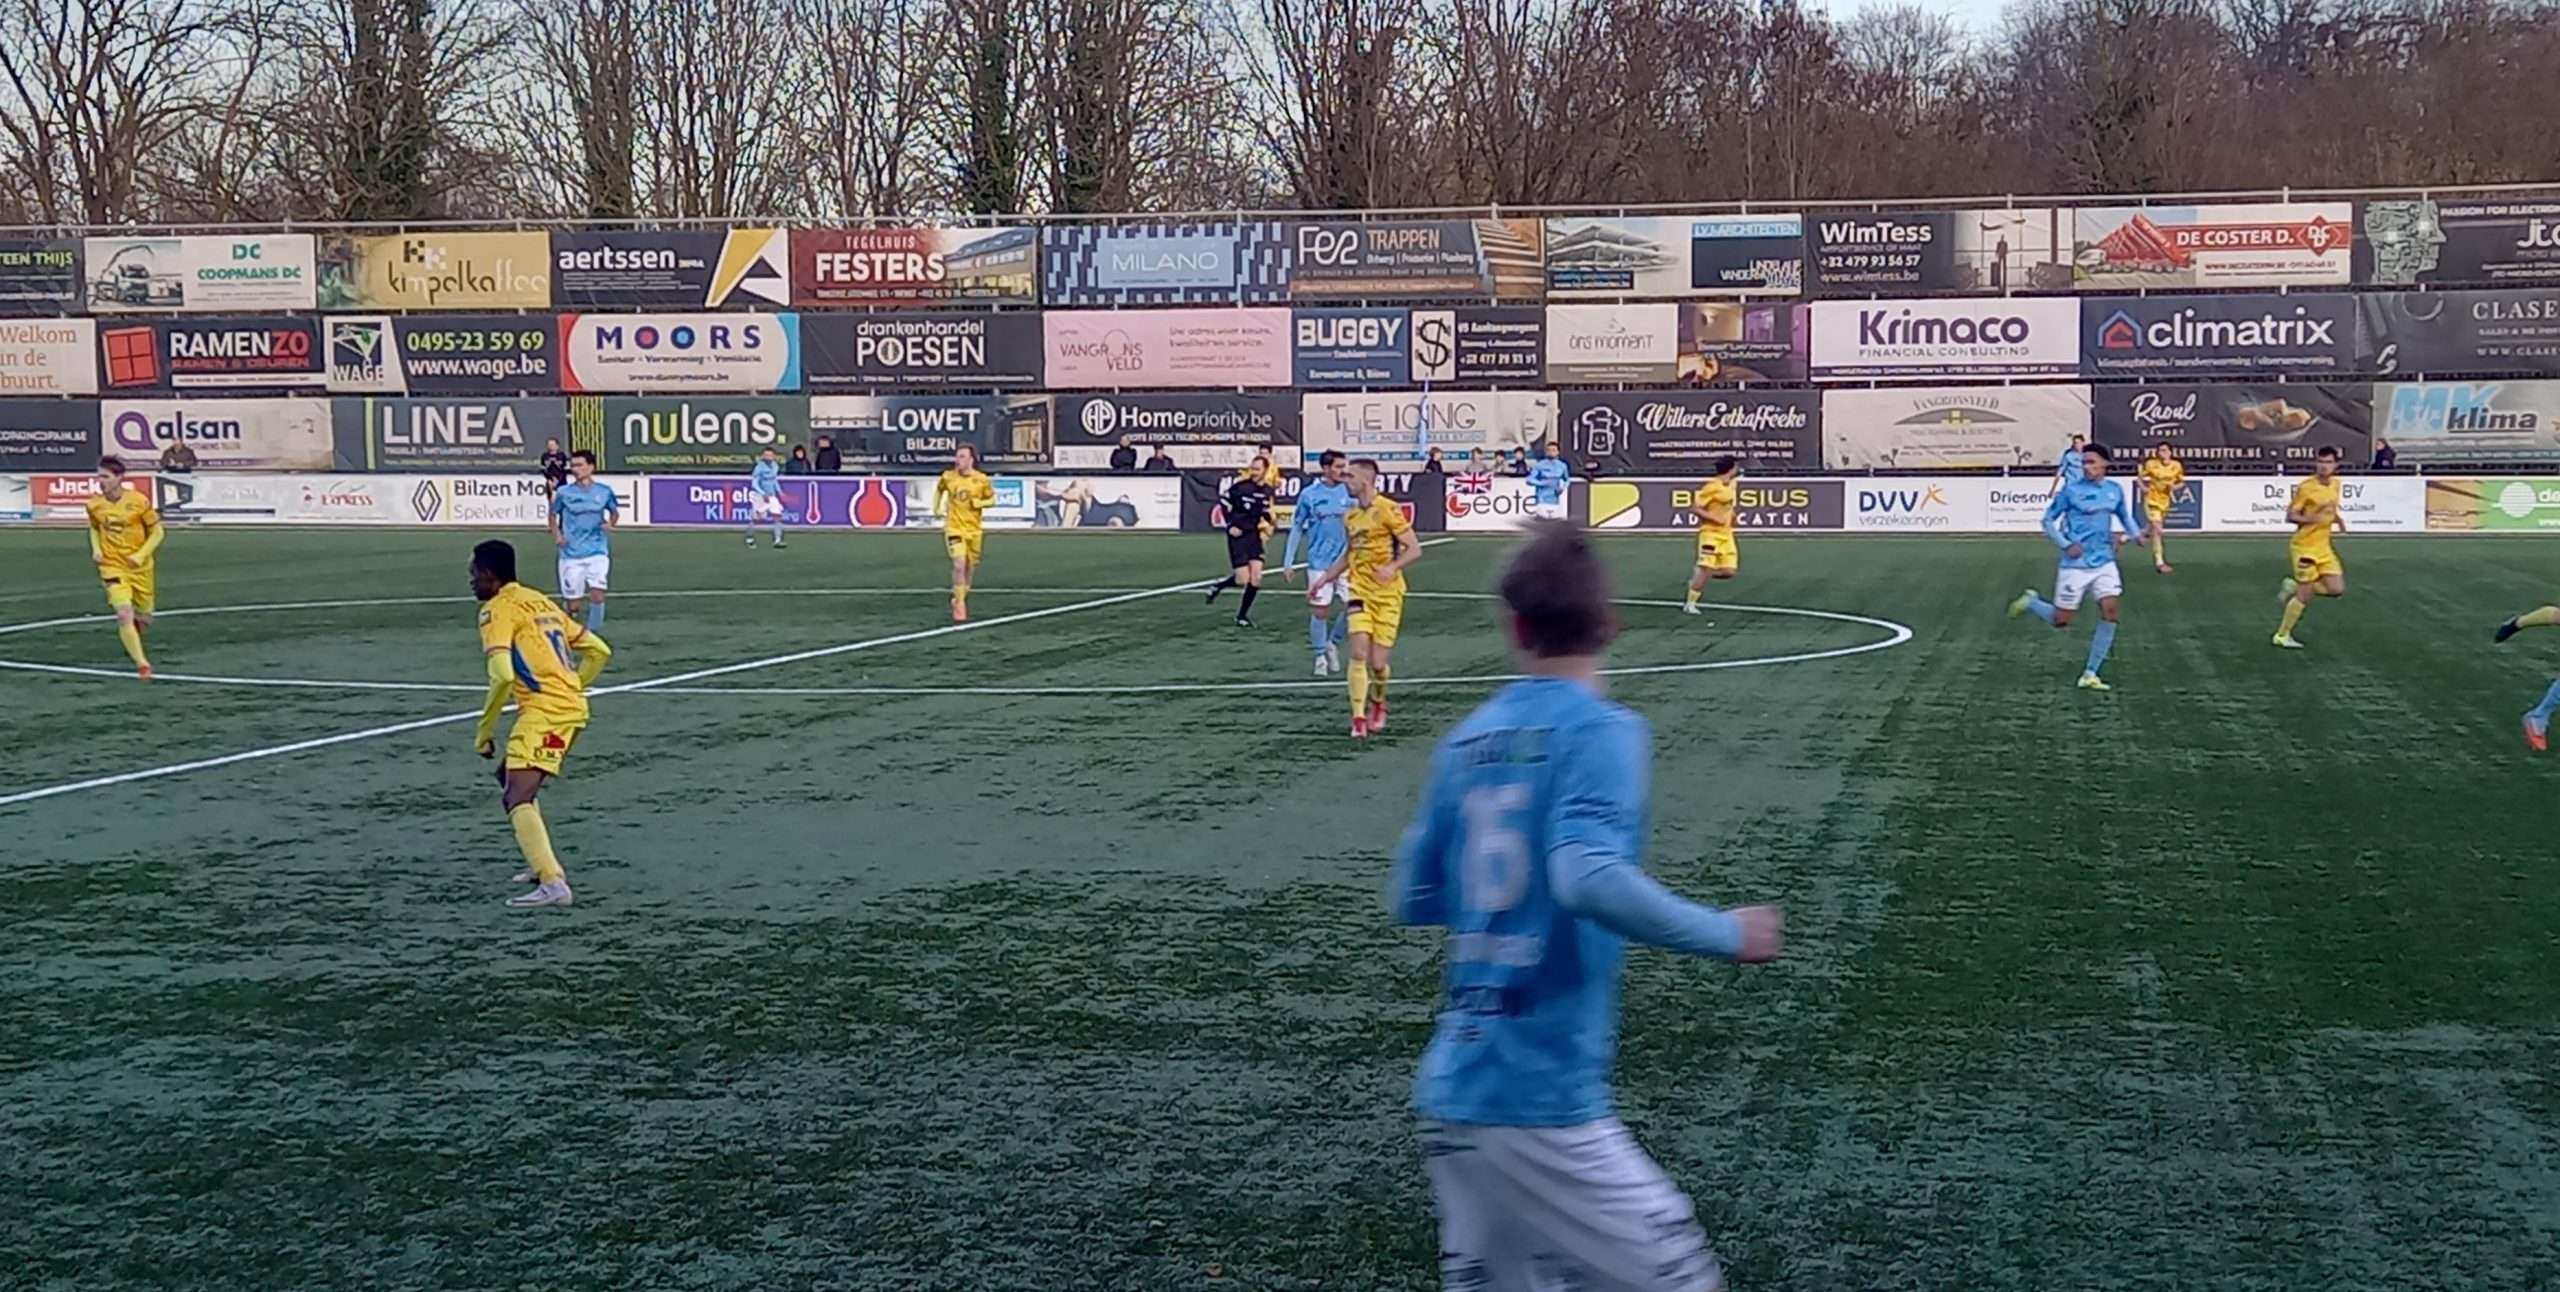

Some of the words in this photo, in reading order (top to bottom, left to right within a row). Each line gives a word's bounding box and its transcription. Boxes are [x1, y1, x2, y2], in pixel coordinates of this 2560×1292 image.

[2486, 206, 2507, 215] FOR
[845, 234, 917, 250] TEGELHUIS
[1366, 228, 1440, 250] TRAPPEN
[1820, 221, 1932, 244] WimTess
[2176, 230, 2201, 247] DE
[2203, 229, 2272, 246] COSTER
[2276, 229, 2295, 244] D.
[33, 251, 73, 268] THIJS
[231, 243, 262, 260] DC
[558, 245, 676, 270] aertssen
[1820, 256, 1844, 267] +32
[1845, 255, 1869, 267] 479
[1870, 255, 1886, 266] 93
[1887, 254, 1904, 266] 56
[1905, 254, 1921, 266] 57
[815, 252, 945, 283] FESTERS
[1112, 252, 1219, 272] MILANO
[197, 267, 279, 281] COOPMANS
[282, 265, 302, 280] DC
[0, 327, 77, 344] Welkom
[856, 319, 985, 337] drankenhandel
[1296, 317, 1403, 347] BUGGY
[1859, 307, 2029, 346] Krimaco
[2147, 306, 2335, 348] climatrix
[169, 331, 311, 358] RAMENZO
[406, 331, 484, 352] 0495-23
[489, 331, 515, 351] 59
[519, 330, 545, 351] 69
[595, 324, 761, 351] MOORS
[28, 349, 47, 366] de
[856, 336, 985, 367] POESEN
[1859, 347, 1934, 358] FINANCIAL
[1937, 346, 2030, 357] CONSULTING
[332, 363, 384, 382] WAGE
[406, 352, 547, 380] www.wage.be
[1106, 356, 1143, 372] VELD
[2130, 391, 2198, 423] Raoul
[383, 404, 524, 445] LINEA
[623, 402, 787, 446] nulens.
[881, 408, 982, 432] LOWET
[2446, 407, 2538, 431] klima
[906, 436, 957, 451] BILZEN
[453, 479, 512, 497] Bilzen
[2263, 484, 2286, 499] De
[2341, 484, 2365, 499] BV
[1859, 490, 1919, 512] DVV
[452, 503, 509, 521] Spelver
[1671, 512, 1811, 526] ADCATEN
[1858, 512, 1950, 528] verzekeringen
